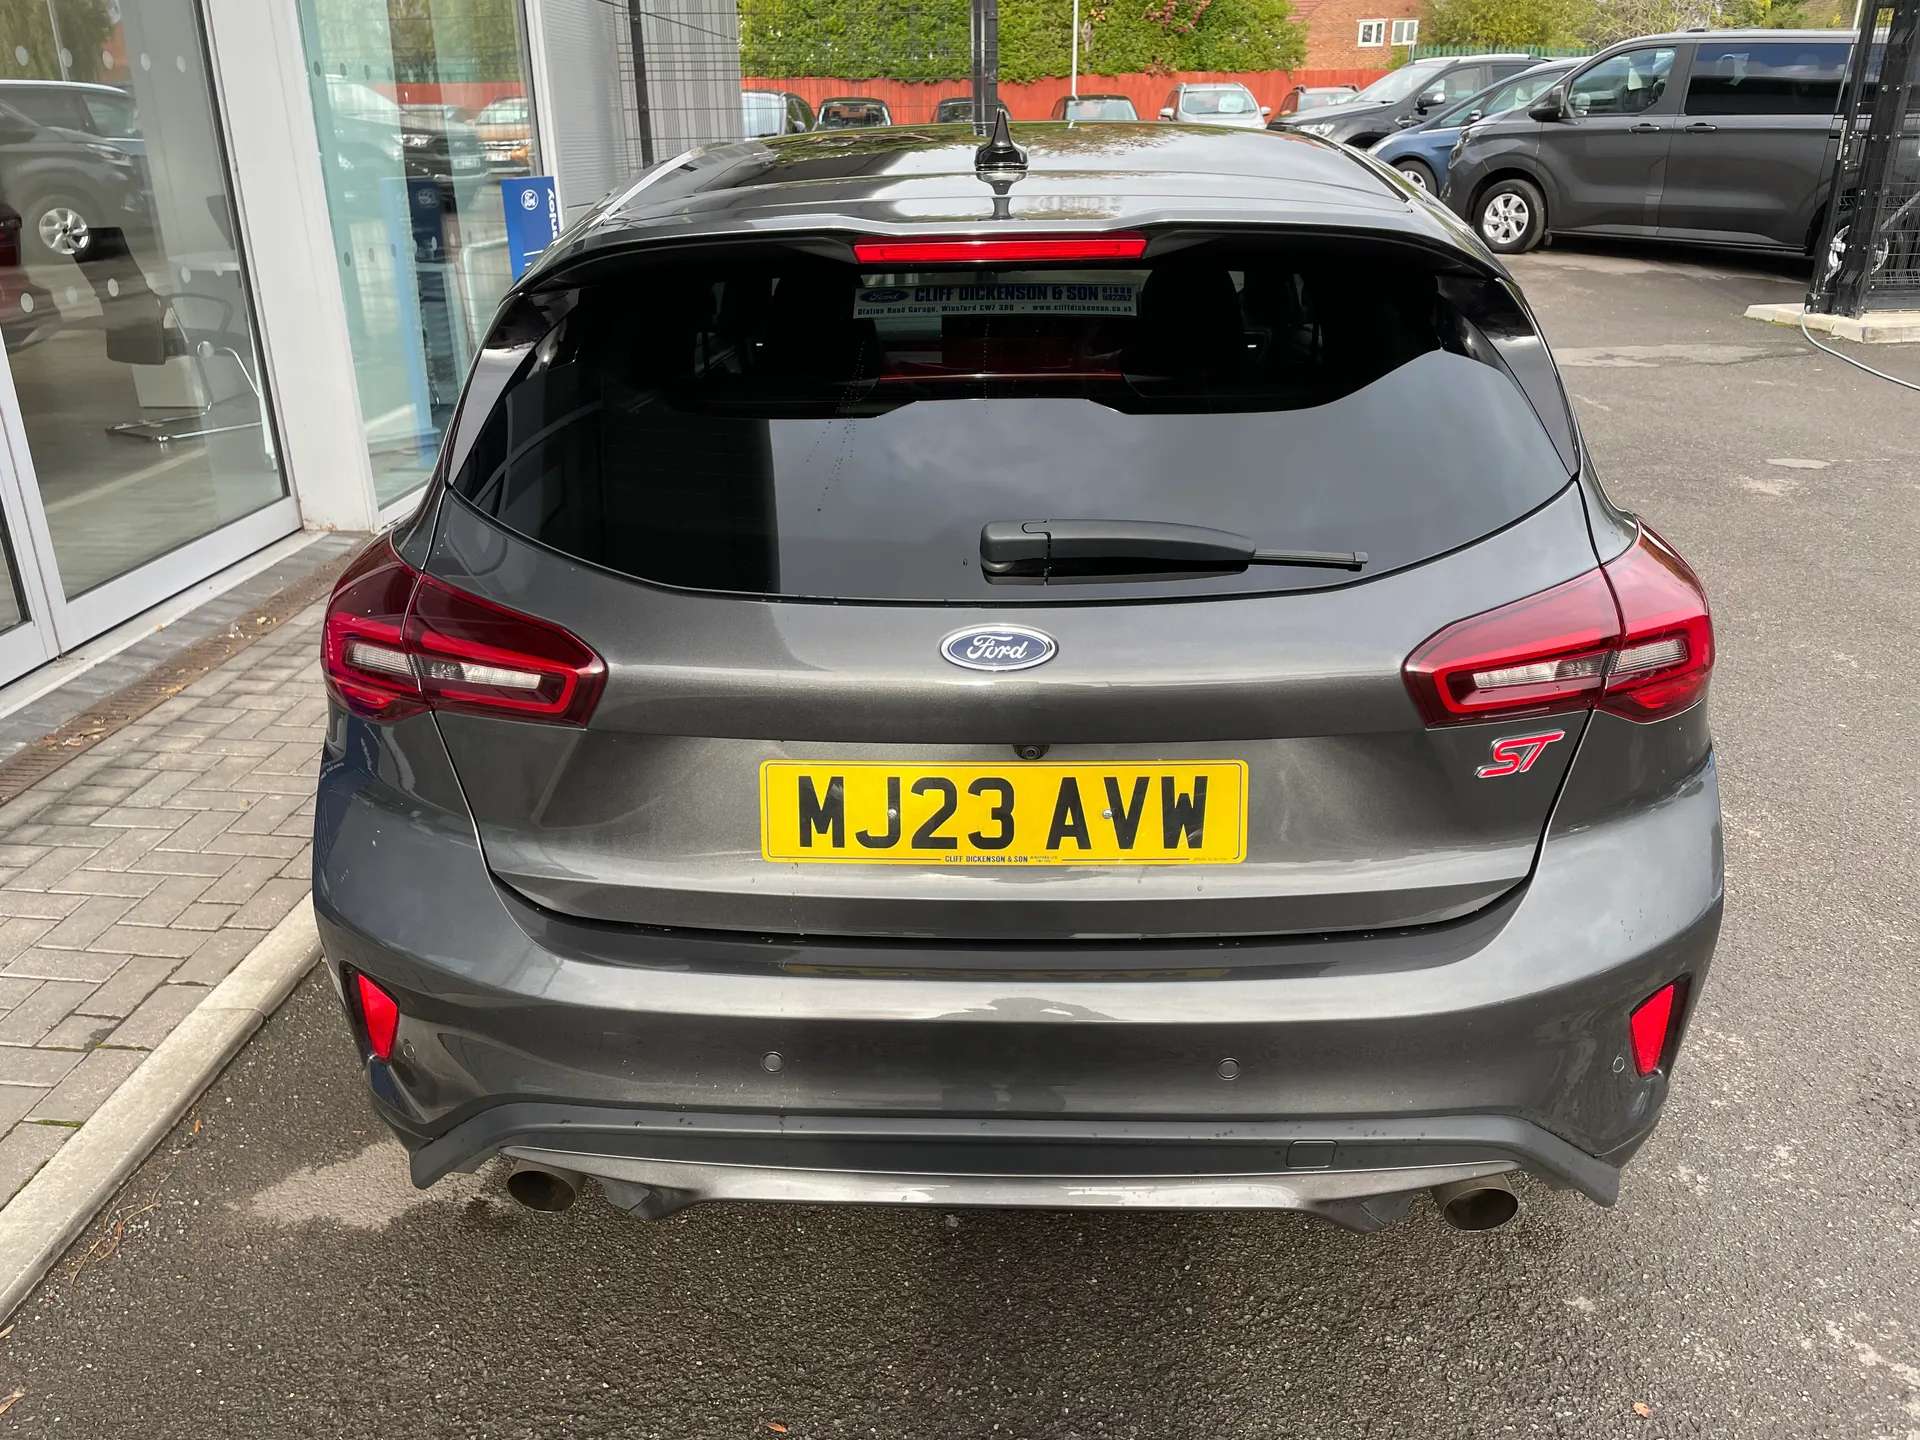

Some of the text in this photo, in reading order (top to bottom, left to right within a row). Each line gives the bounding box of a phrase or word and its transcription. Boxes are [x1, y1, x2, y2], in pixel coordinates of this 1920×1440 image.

[914, 287, 955, 302] CLIFF
[959, 285, 1048, 301] DICKENSON
[1066, 286, 1099, 301] SON
[966, 635, 1028, 659] Ford
[1475, 729, 1566, 778] ST
[799, 775, 1209, 850] MJ23 AVW
[944, 855, 963, 863] CLIFF
[965, 855, 1006, 863] DICKENSON
[1013, 855, 1029, 863] SON
